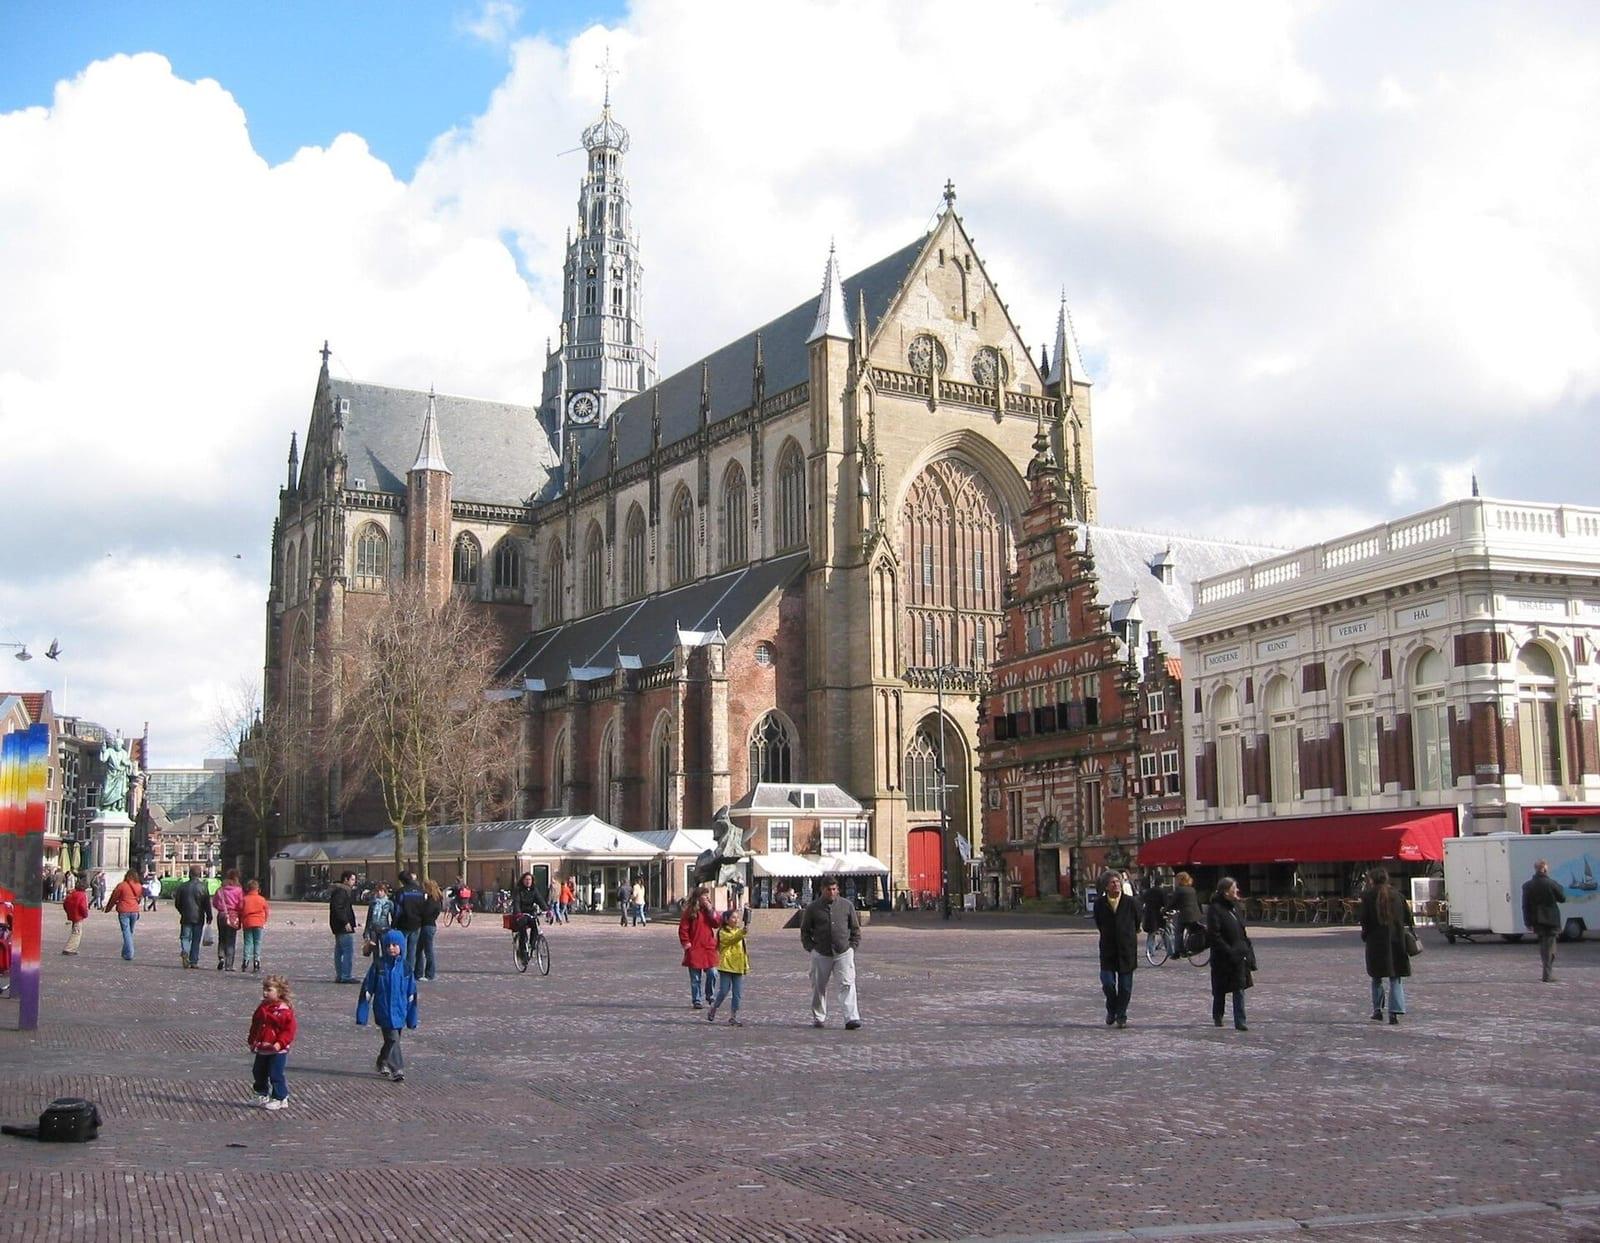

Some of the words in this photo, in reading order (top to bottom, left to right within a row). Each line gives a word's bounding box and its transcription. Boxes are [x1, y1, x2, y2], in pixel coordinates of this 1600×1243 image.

[1413, 609, 1430, 620] HAL
[1339, 622, 1367, 636] VERWEY
[1267, 640, 1288, 652] KUNST
[1209, 651, 1239, 665] MODERNE
